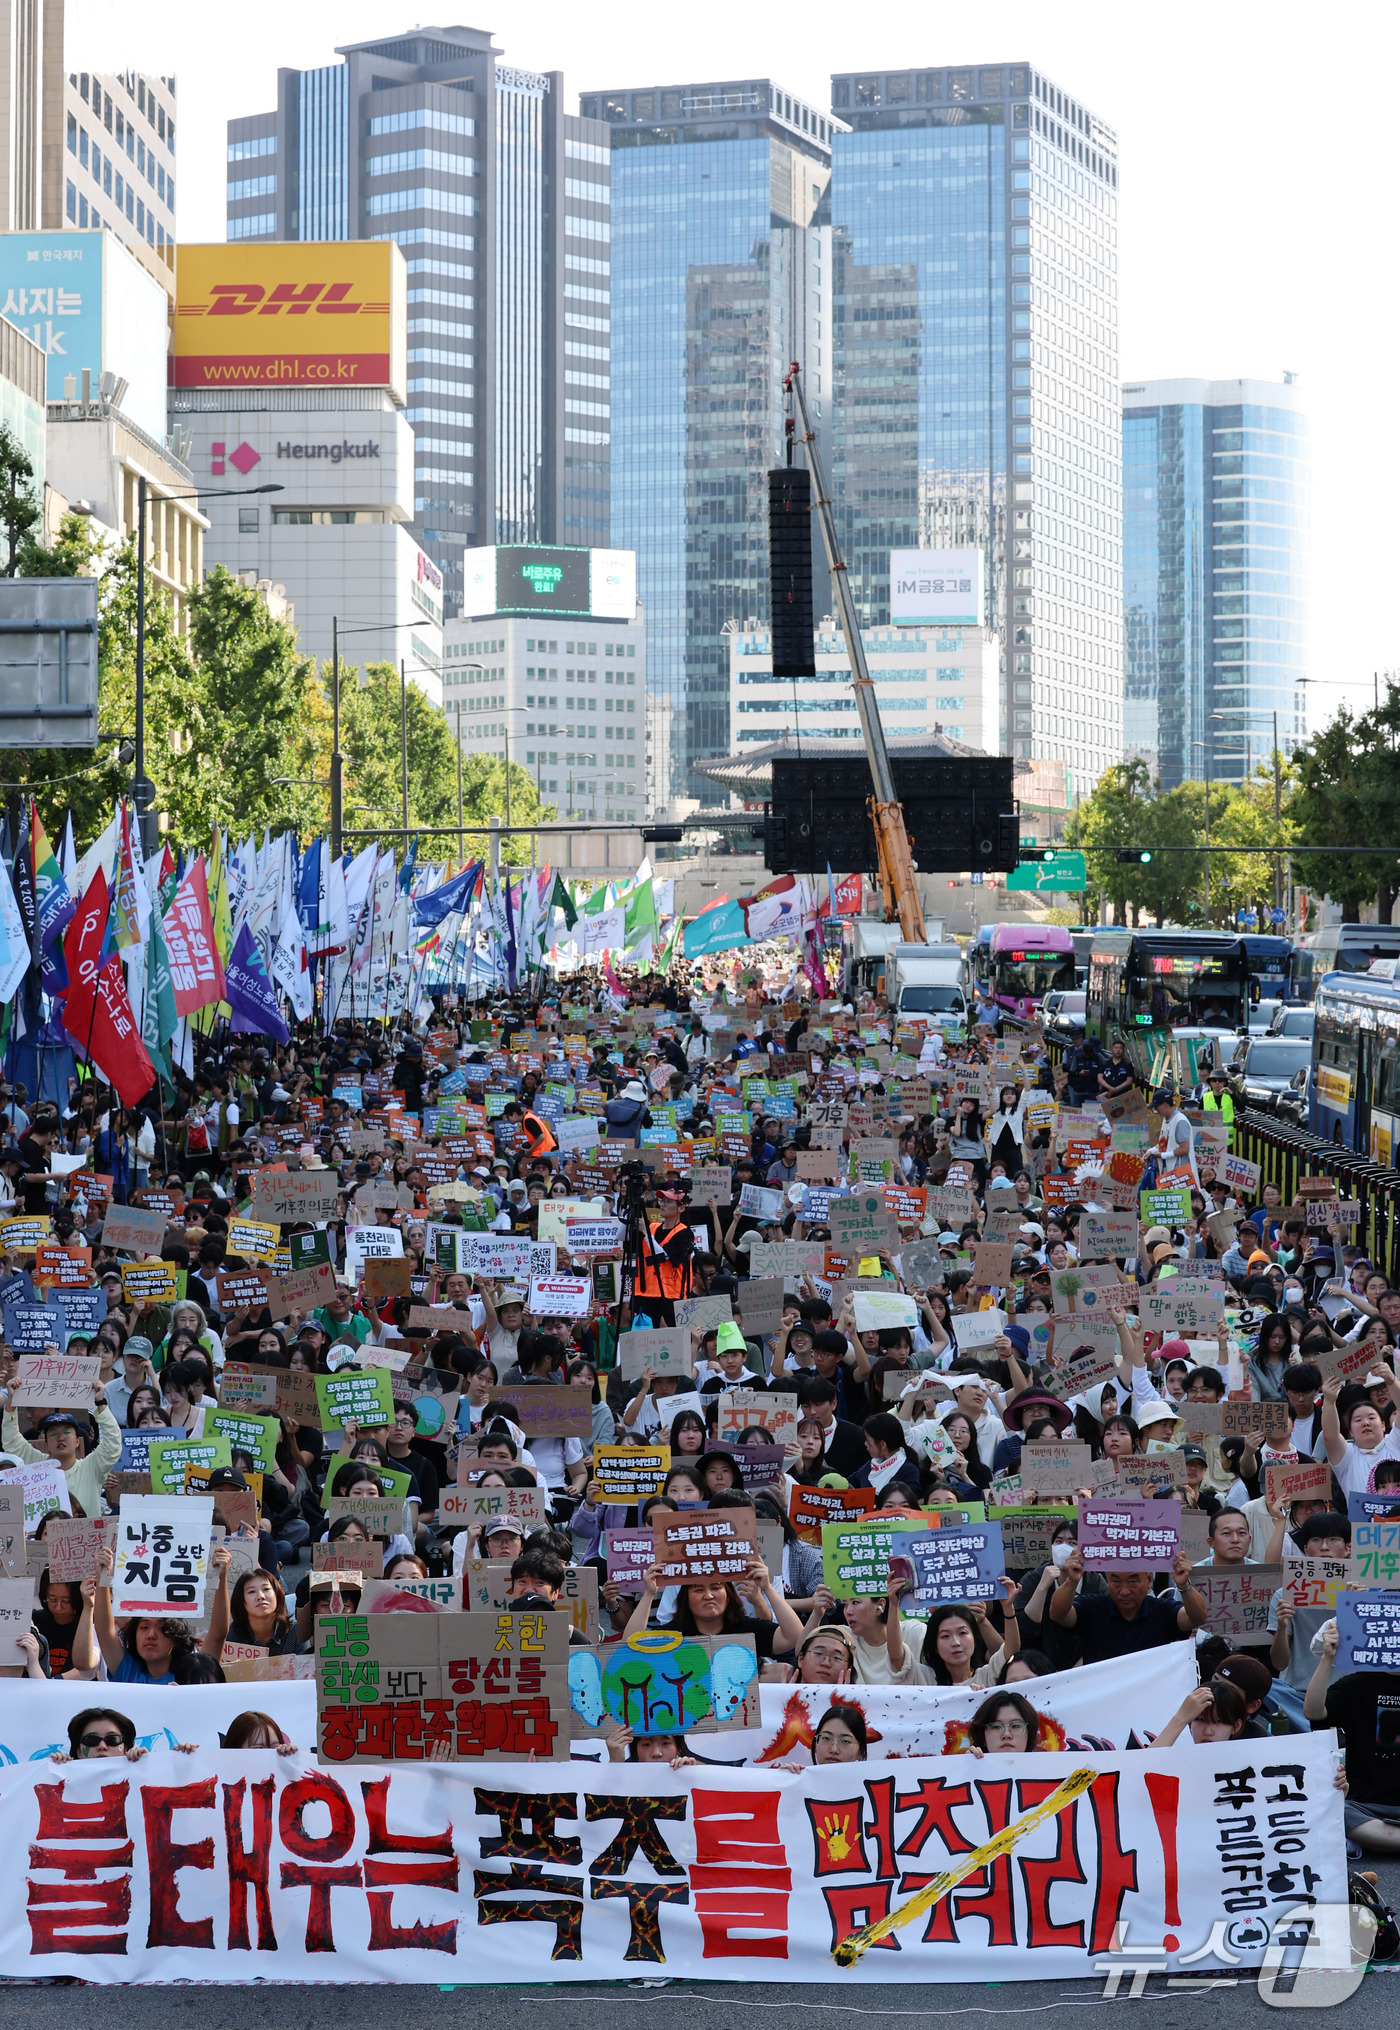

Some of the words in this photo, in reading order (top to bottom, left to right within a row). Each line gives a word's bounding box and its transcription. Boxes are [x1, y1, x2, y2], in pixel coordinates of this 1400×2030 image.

[42, 249, 82, 261] 한국제지
[207, 283, 363, 315] DHL
[203, 360, 358, 380] www.dhl.co.kr
[277, 441, 380, 463] Heungkuk
[522, 565, 563, 580] 바로주유
[534, 581, 554, 593] 완료!
[178, 882, 216, 981] 기후위기
[1267, 964, 1281, 973] 401
[816, 1104, 844, 1124] 기후
[1225, 1170, 1256, 1189] 힘들다
[260, 1176, 323, 1202] 청년에게
[544, 1203, 565, 1213] 태양
[830, 1200, 861, 1212] 지구는
[1308, 1202, 1328, 1220] 성산
[360, 1245, 393, 1257] 그대로
[753, 1243, 795, 1257] SAVE
[753, 1258, 795, 1273] SAVE
[956, 1320, 973, 1329] 지구
[1174, 1308, 1218, 1327] 행동으로
[20, 1322, 33, 1330] 도구
[12, 1339, 27, 1348] 메가
[28, 1340, 42, 1349] 폭주
[26, 1358, 98, 1378] 기후위기에서
[21, 1381, 47, 1397] 누가
[327, 1381, 351, 1393] 모두의
[351, 1378, 377, 1390] 존엄한
[335, 1391, 353, 1401] 삶과
[354, 1390, 371, 1400] 노동
[328, 1404, 351, 1416] 생태적
[352, 1401, 379, 1413] 전환과
[1227, 1402, 1264, 1414] 네팔의
[1265, 1404, 1285, 1419] 물결
[214, 1417, 238, 1430] 모두의
[239, 1422, 264, 1435] 존엄한
[366, 1412, 388, 1424] 강화!
[221, 1428, 239, 1440] 삶과
[240, 1432, 256, 1445] 노동
[162, 1449, 189, 1461] 모두의
[189, 1446, 216, 1458] 존엄한
[600, 1457, 661, 1469] 탈핵·탈화석연료!
[596, 1468, 651, 1481] 공공재생에너지
[1281, 1474, 1302, 1488] 지구를
[1302, 1467, 1328, 1482] 불태우는
[603, 1482, 634, 1494] 정의로운
[635, 1482, 657, 1493] 전환!
[1286, 1482, 1306, 1494] 폭주를
[1306, 1476, 1328, 1491] 멈춰라!
[340, 1498, 398, 1514] 재생에너지
[473, 1496, 502, 1516] 지구
[506, 1489, 535, 1507] 혼자
[801, 1492, 843, 1510] 기후파괴,
[796, 1514, 817, 1527] 메가
[1085, 1512, 1131, 1526] 농민권리
[666, 1526, 703, 1542] 노동권
[705, 1522, 735, 1538] 파괴,
[1106, 1527, 1139, 1540] 먹거리
[1141, 1529, 1178, 1544] 기본권,
[613, 1540, 652, 1553] 농민권리
[685, 1542, 723, 1557] 불평등
[724, 1541, 754, 1556] 강화,
[839, 1535, 873, 1548] 모두의
[911, 1536, 985, 1556] 전쟁·집단학살
[851, 1548, 875, 1561] 삶과
[1082, 1545, 1117, 1559] 생태적
[1119, 1545, 1142, 1558] 농업
[1143, 1544, 1171, 1558] 보장!
[689, 1561, 716, 1575] 폭주
[716, 1558, 747, 1574] 멈춰!
[923, 1558, 946, 1571] 도구
[947, 1553, 974, 1566] 삼는,
[1287, 1560, 1349, 1580] 평등·평화
[124, 1555, 199, 1603] 지금
[612, 1570, 641, 1582] 생태적
[839, 1565, 873, 1579] 생태적
[926, 1566, 978, 1585] AI·반도체
[914, 1586, 938, 1600] 메가
[940, 1586, 963, 1598] 폭주
[966, 1583, 994, 1597] 중단!
[1286, 1578, 1327, 1608] 살고
[494, 1614, 548, 1653] 못한
[1366, 1621, 1390, 1635] 도구
[318, 1616, 370, 1658] 고등
[237, 1647, 261, 1660] FOR
[1353, 1651, 1379, 1664] 메가
[320, 1660, 428, 1704] 학생보다
[448, 1656, 547, 1695] 당신들
[1213, 1765, 1268, 1914] 푸른꿈
[1261, 1764, 1323, 1947] 고등학교
[25, 1768, 460, 1956] 불태우는
[472, 1786, 793, 1963] 폭주를
[803, 1768, 1181, 1958] 멈춰라!
